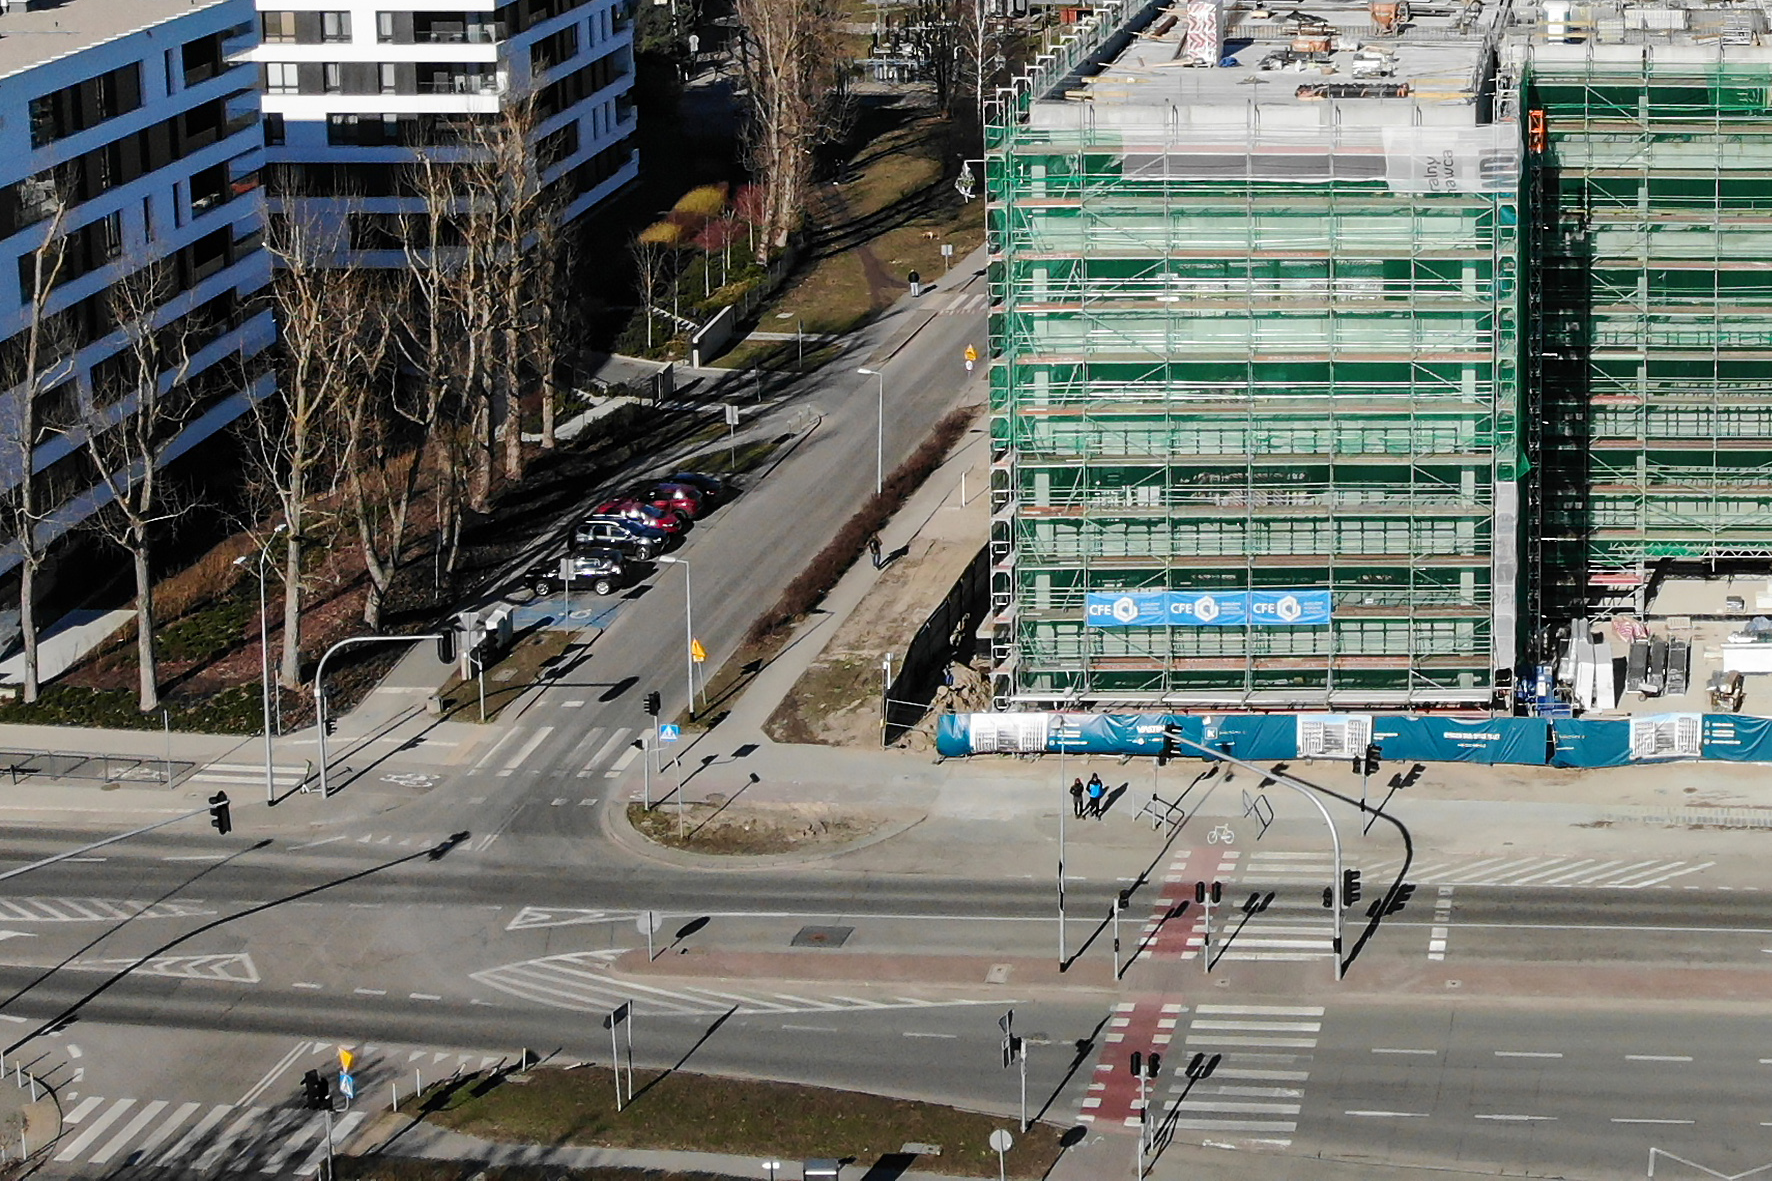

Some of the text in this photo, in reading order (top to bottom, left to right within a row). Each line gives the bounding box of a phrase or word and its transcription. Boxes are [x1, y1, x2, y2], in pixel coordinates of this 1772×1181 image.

[1089, 604, 1111, 615] CFE
[1170, 603, 1192, 613] CFE
[1253, 603, 1275, 613] CFE
